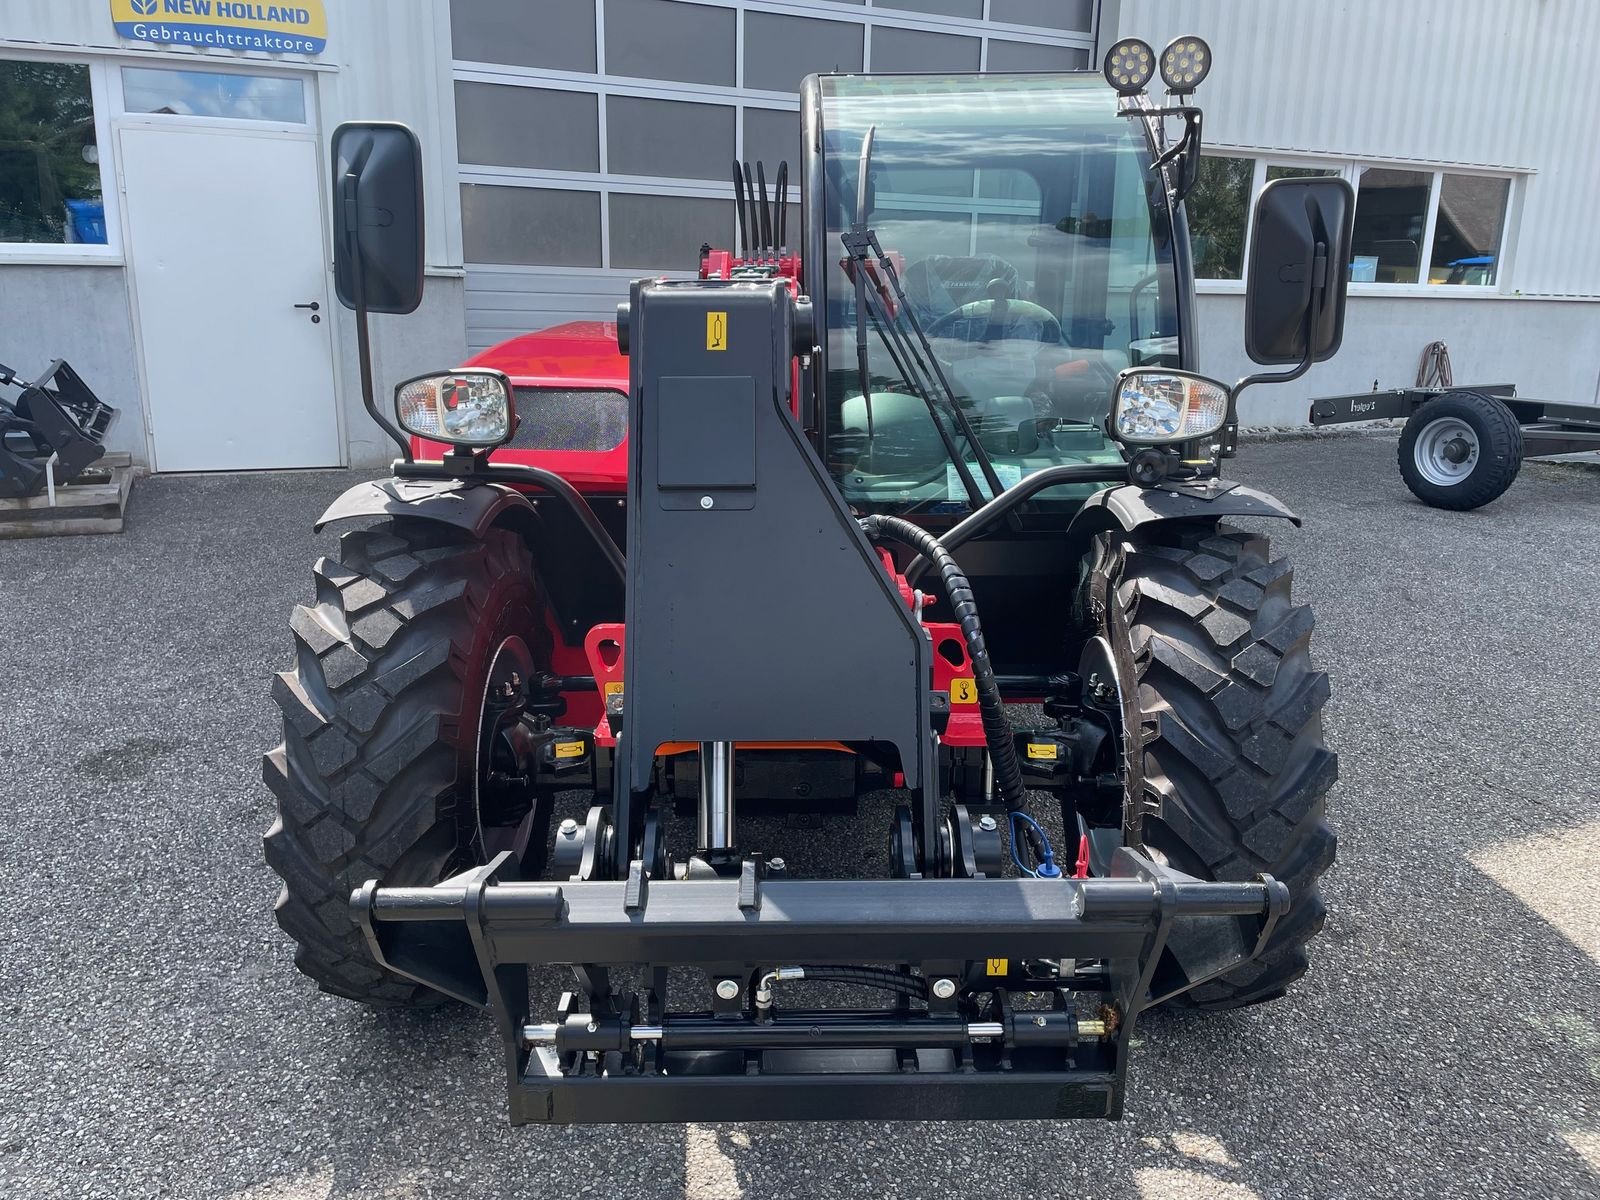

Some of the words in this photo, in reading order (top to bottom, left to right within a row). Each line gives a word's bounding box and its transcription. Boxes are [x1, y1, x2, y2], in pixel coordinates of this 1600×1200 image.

[164, 0, 211, 16] NEW
[217, 1, 310, 25] HOLLAND
[133, 24, 313, 51] Gebrauchttraktore
